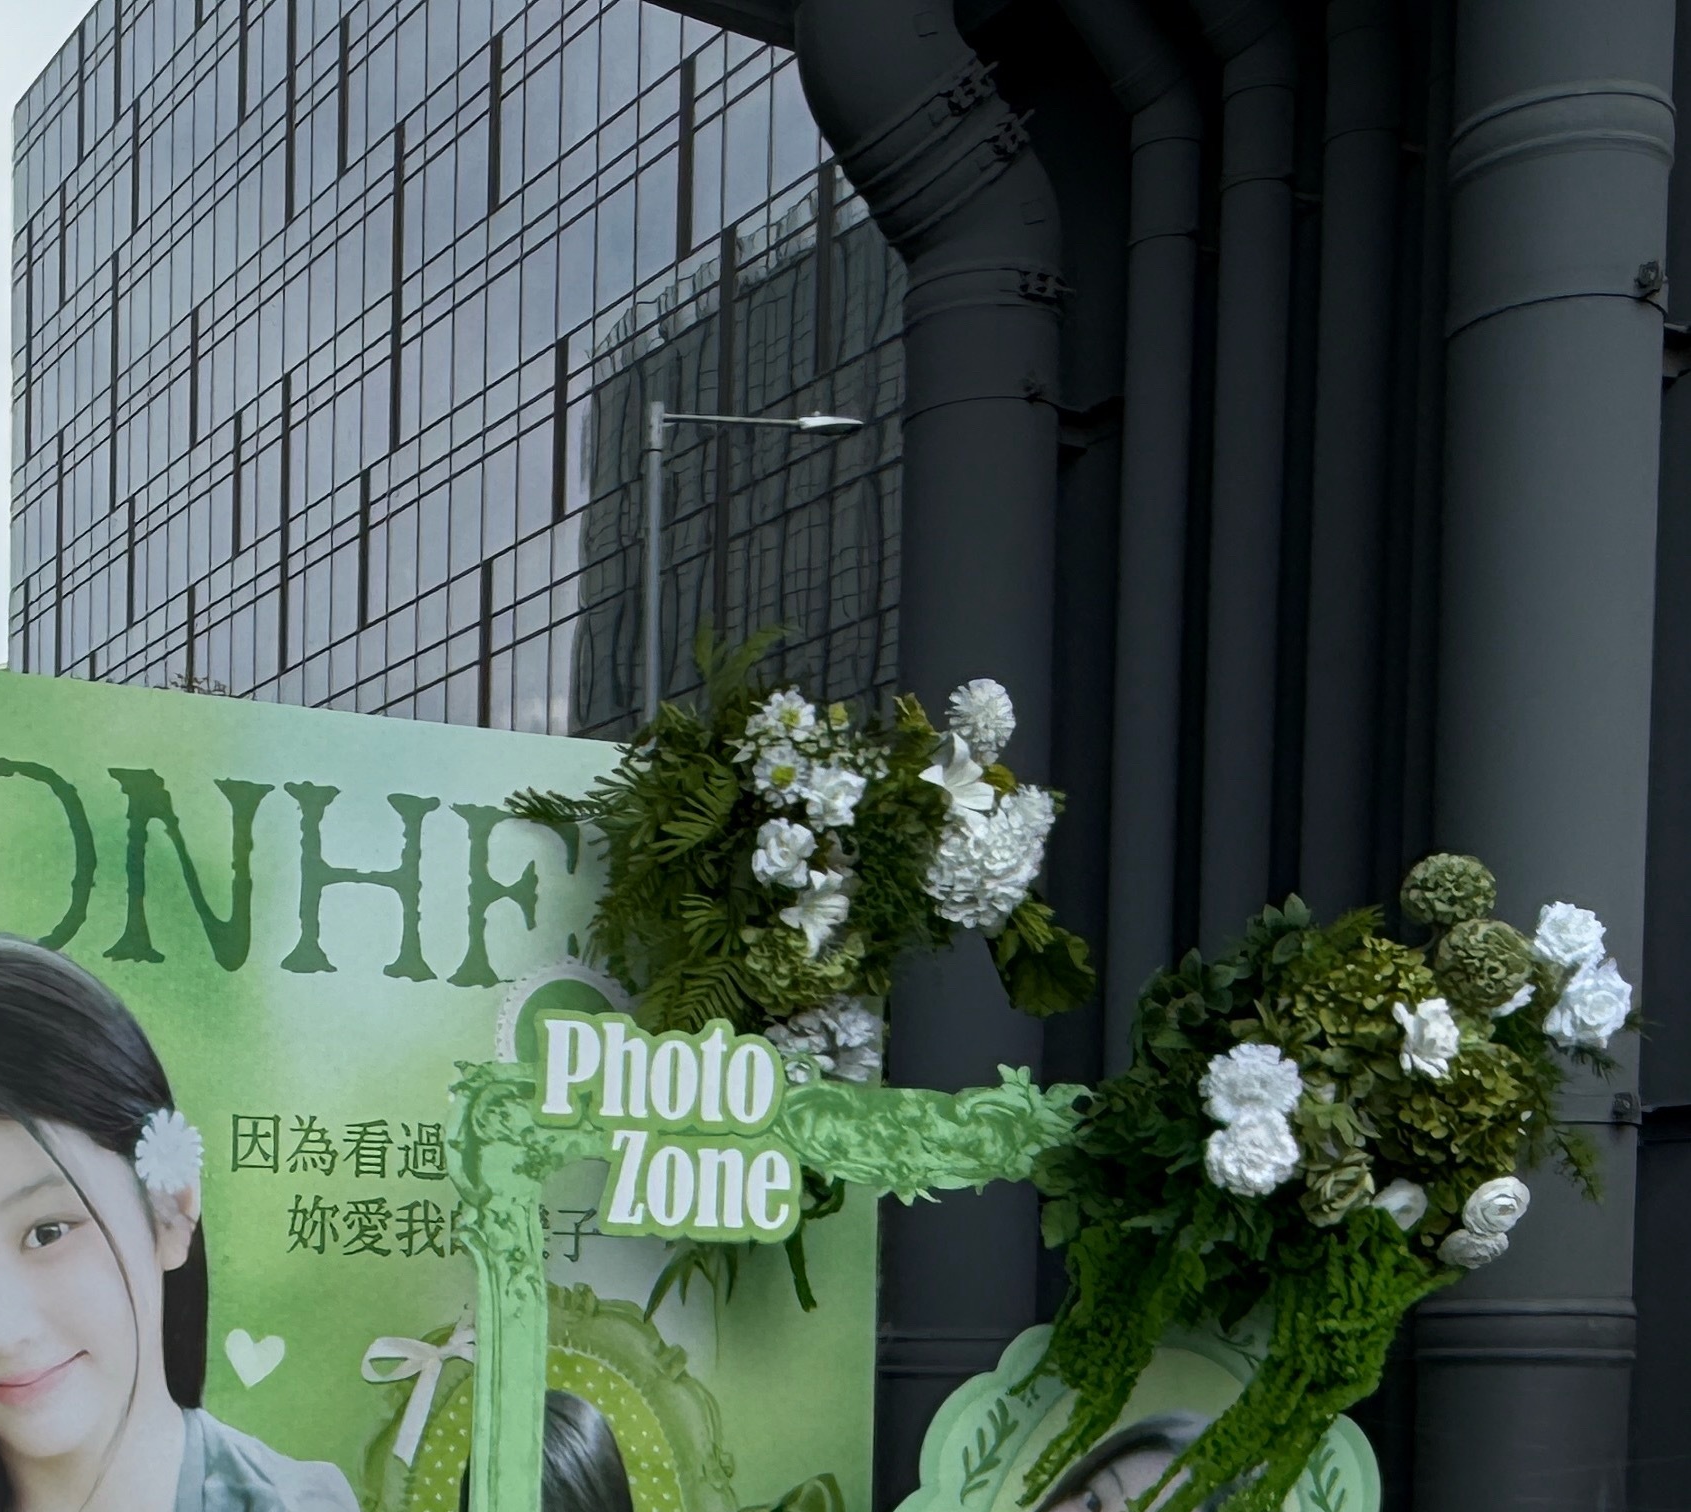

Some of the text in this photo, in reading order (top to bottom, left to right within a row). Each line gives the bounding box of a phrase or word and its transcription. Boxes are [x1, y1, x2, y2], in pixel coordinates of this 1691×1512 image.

[541, 1018, 777, 1125] Photo
[231, 1113, 447, 1181] 因為看過
[608, 1130, 792, 1231] Zone
[286, 1194, 604, 1263] 妳愛我子
